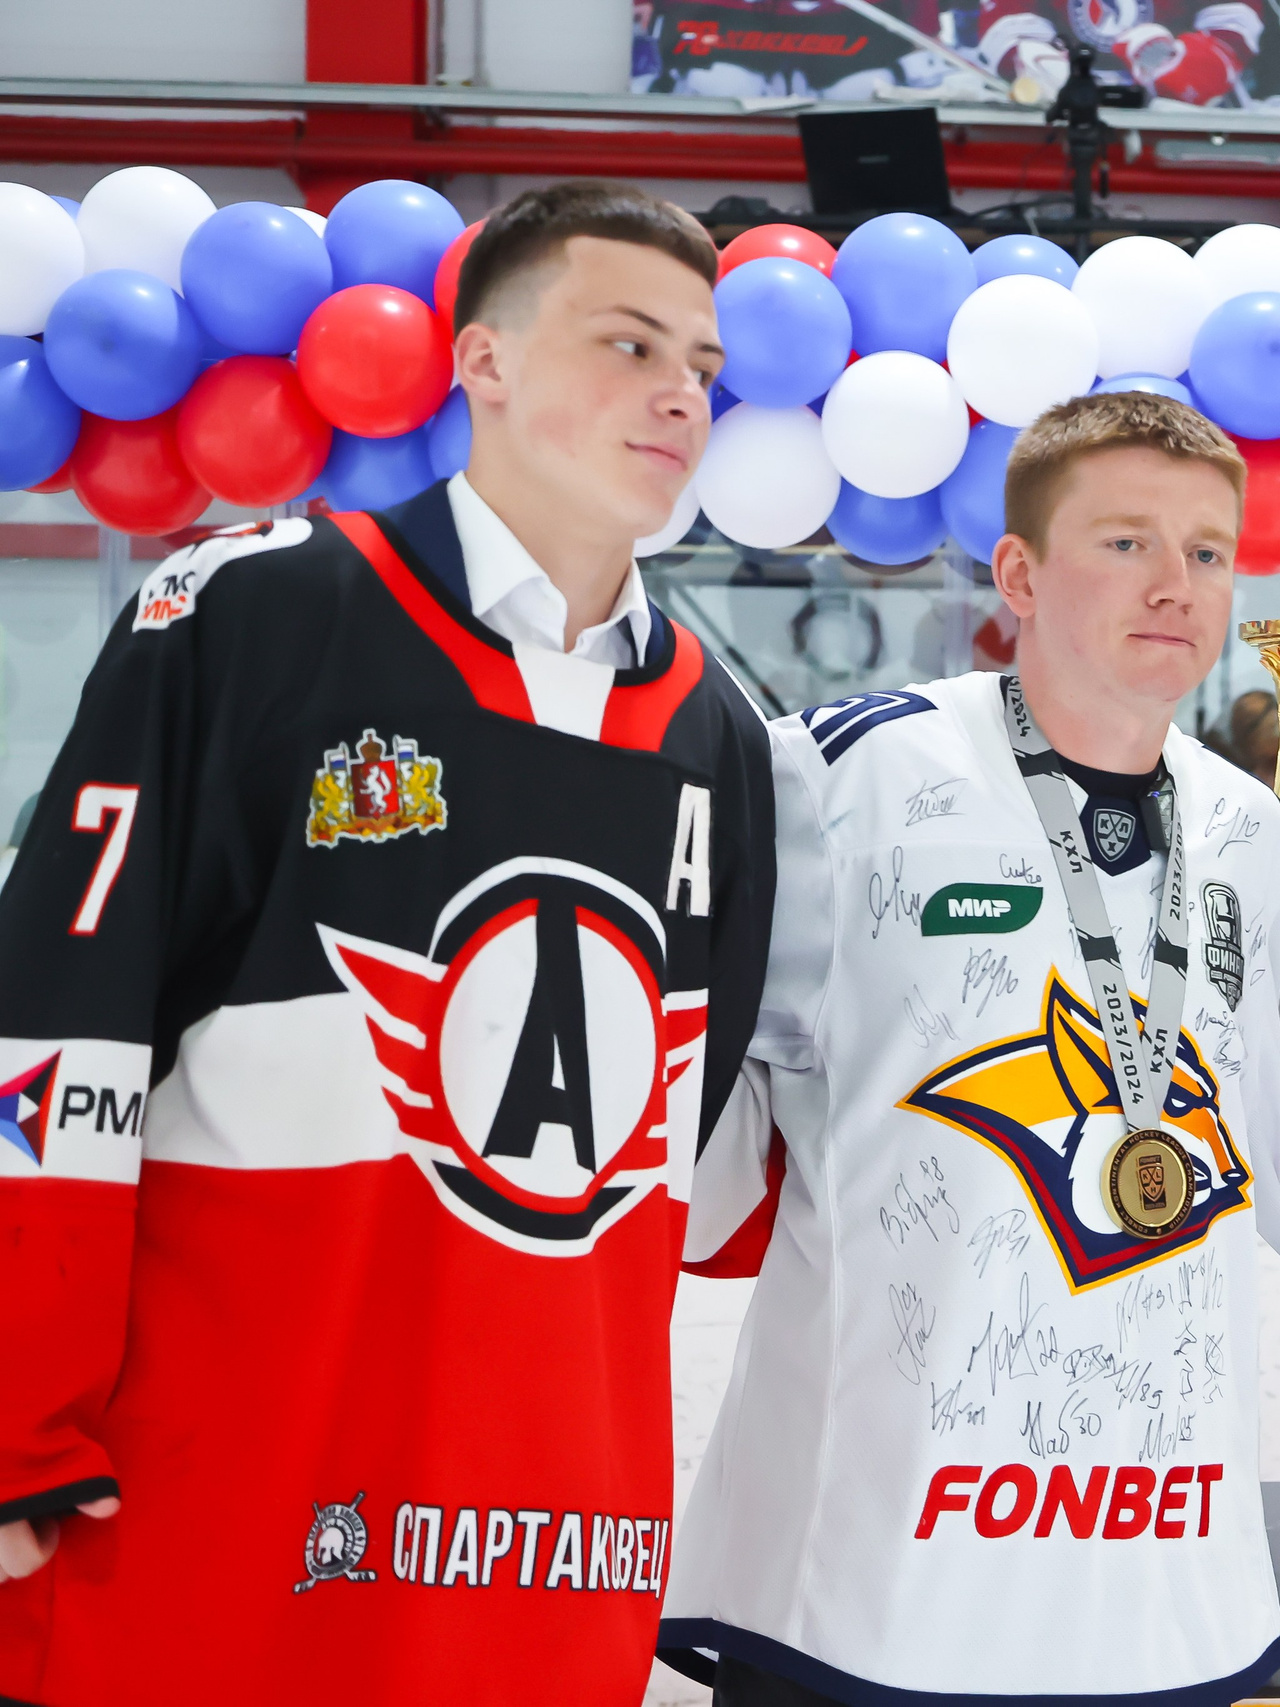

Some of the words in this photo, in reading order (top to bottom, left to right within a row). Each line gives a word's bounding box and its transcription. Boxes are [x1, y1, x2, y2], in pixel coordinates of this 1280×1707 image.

[68, 781, 141, 936] 7
[1059, 830, 1083, 874] КХЛ
[948, 898, 1012, 918] МИР
[1102, 983, 1144, 1105] 2023/2024
[1149, 1028, 1168, 1073] КХЛ
[58, 1084, 142, 1138] РМ
[914, 1463, 1223, 1540] FONBET
